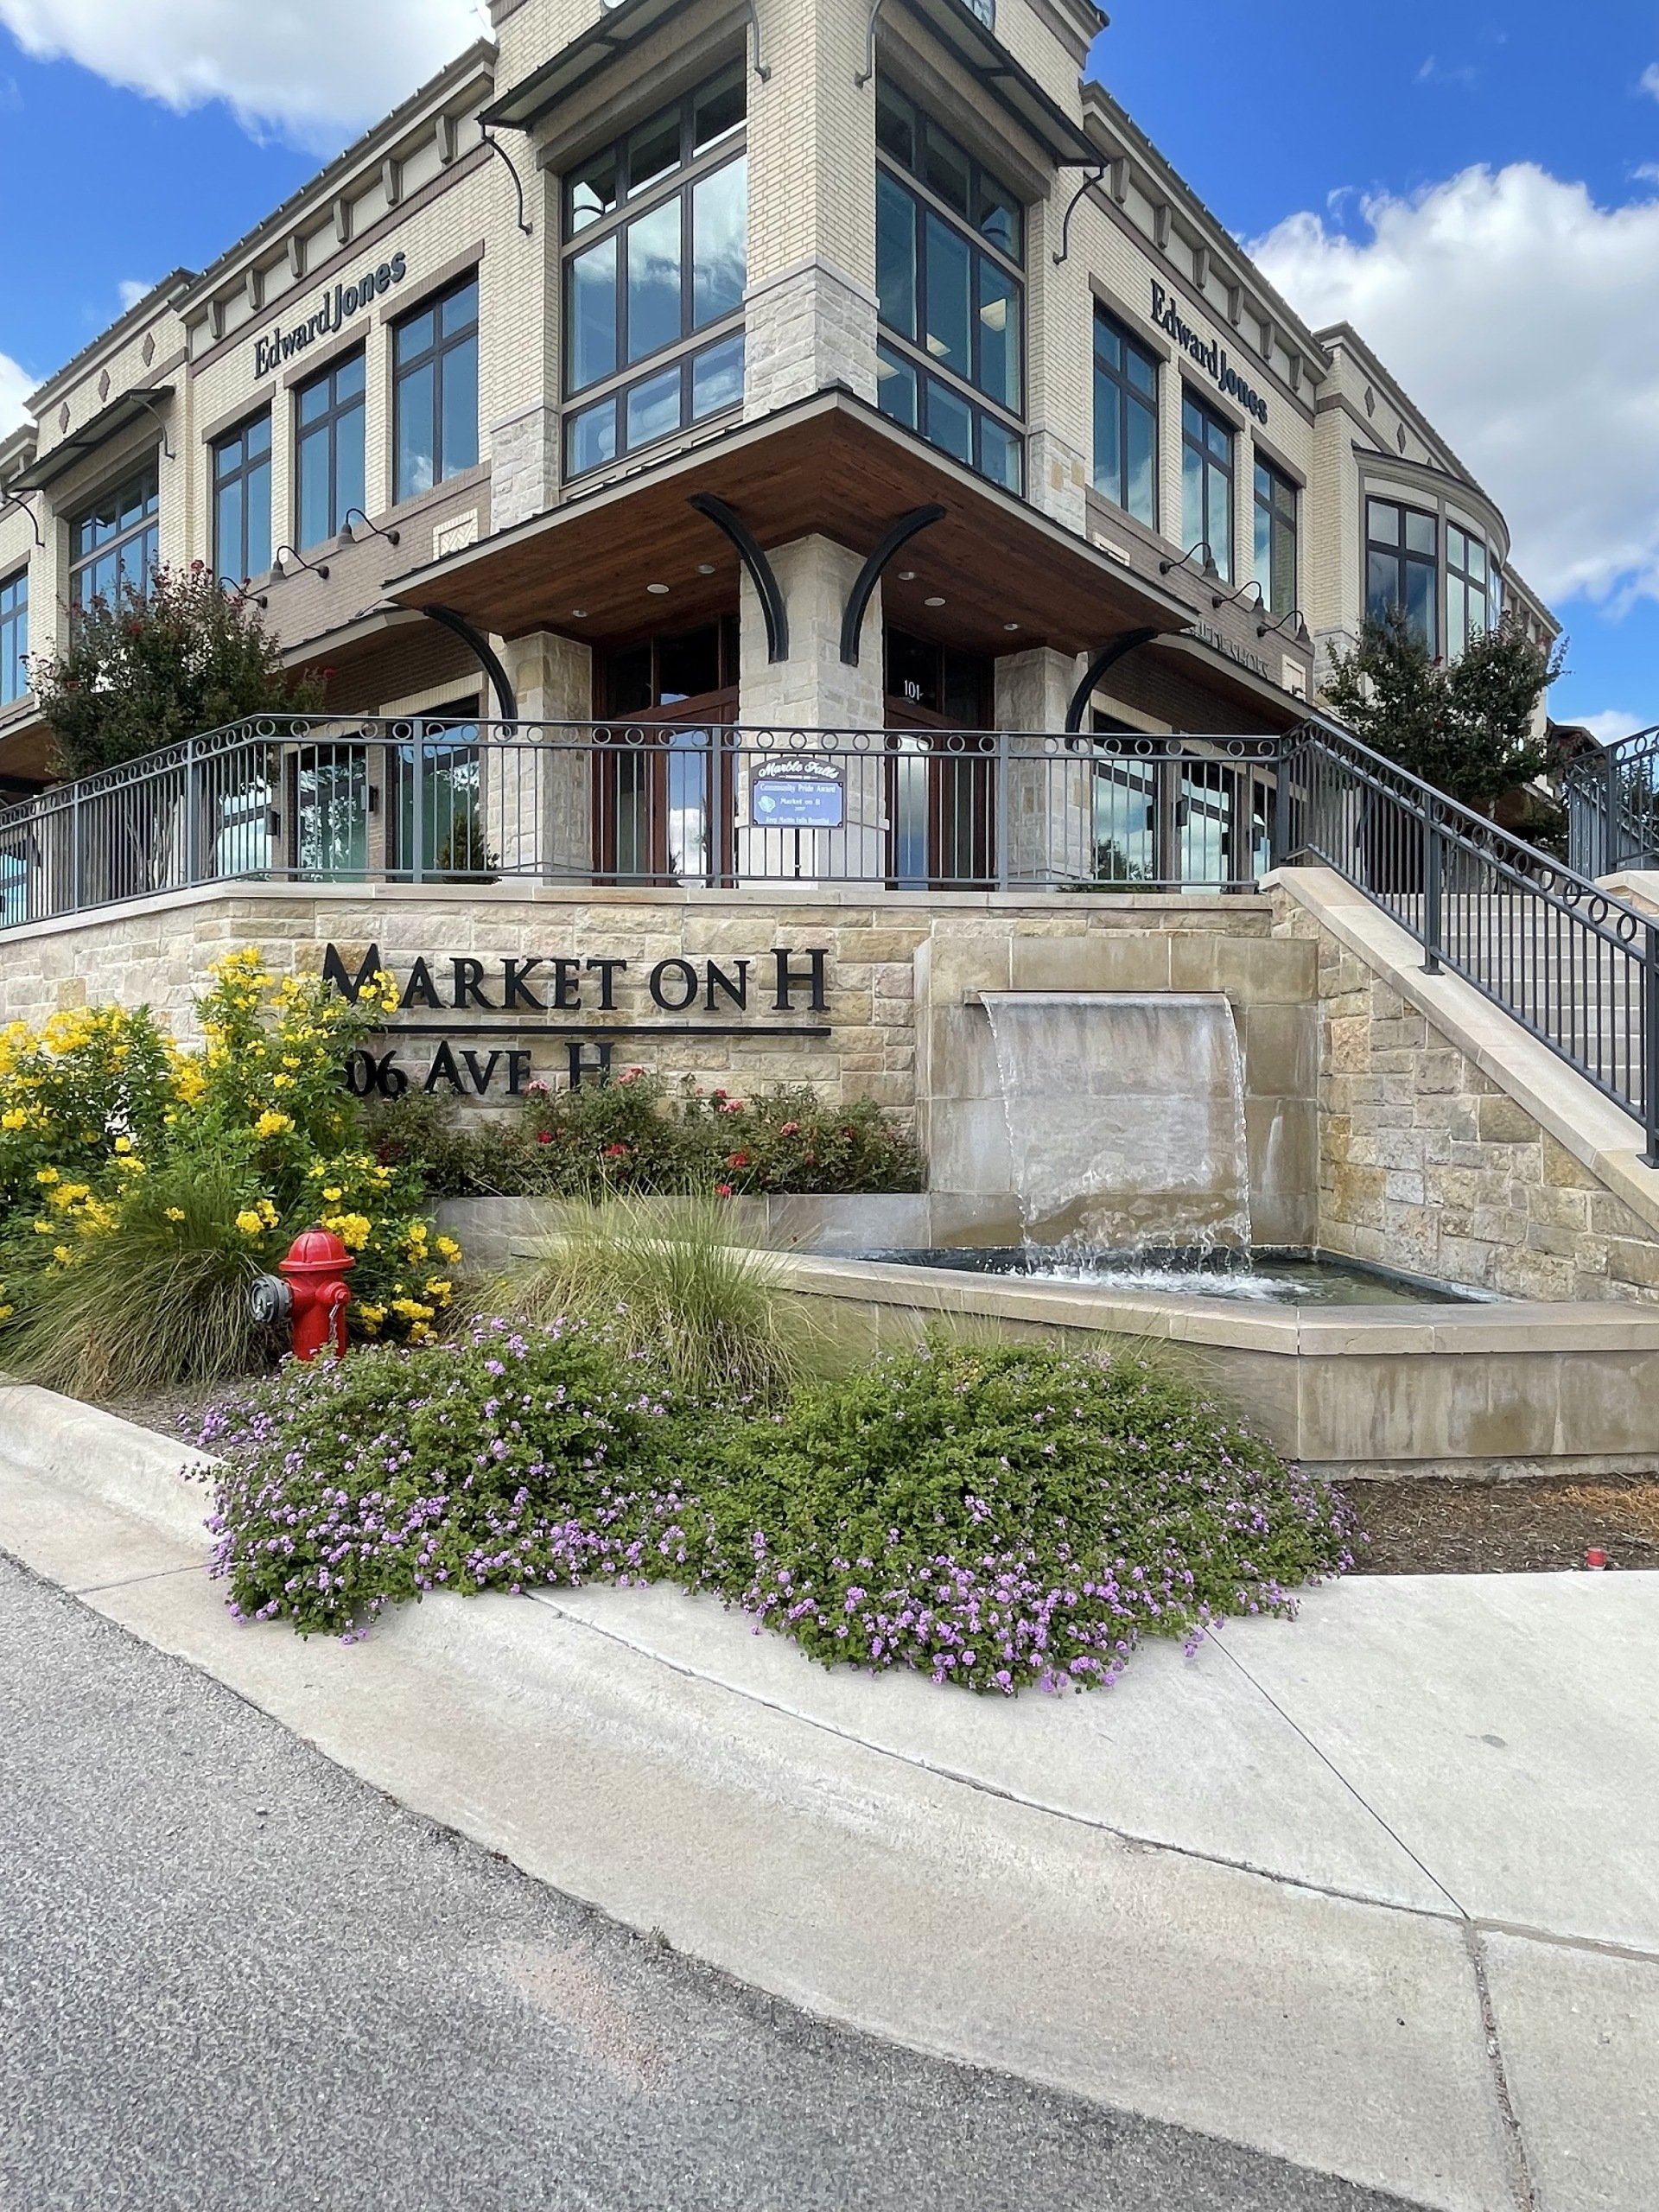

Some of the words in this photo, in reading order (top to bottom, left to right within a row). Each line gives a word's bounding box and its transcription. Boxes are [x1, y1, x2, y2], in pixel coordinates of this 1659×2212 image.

[904, 679, 920, 701] 101
[759, 760, 804, 778] Marble
[804, 761, 840, 779] Falls
[650, 958, 751, 1011] ON
[770, 948, 831, 1011] H
[565, 1042, 615, 1091] H
